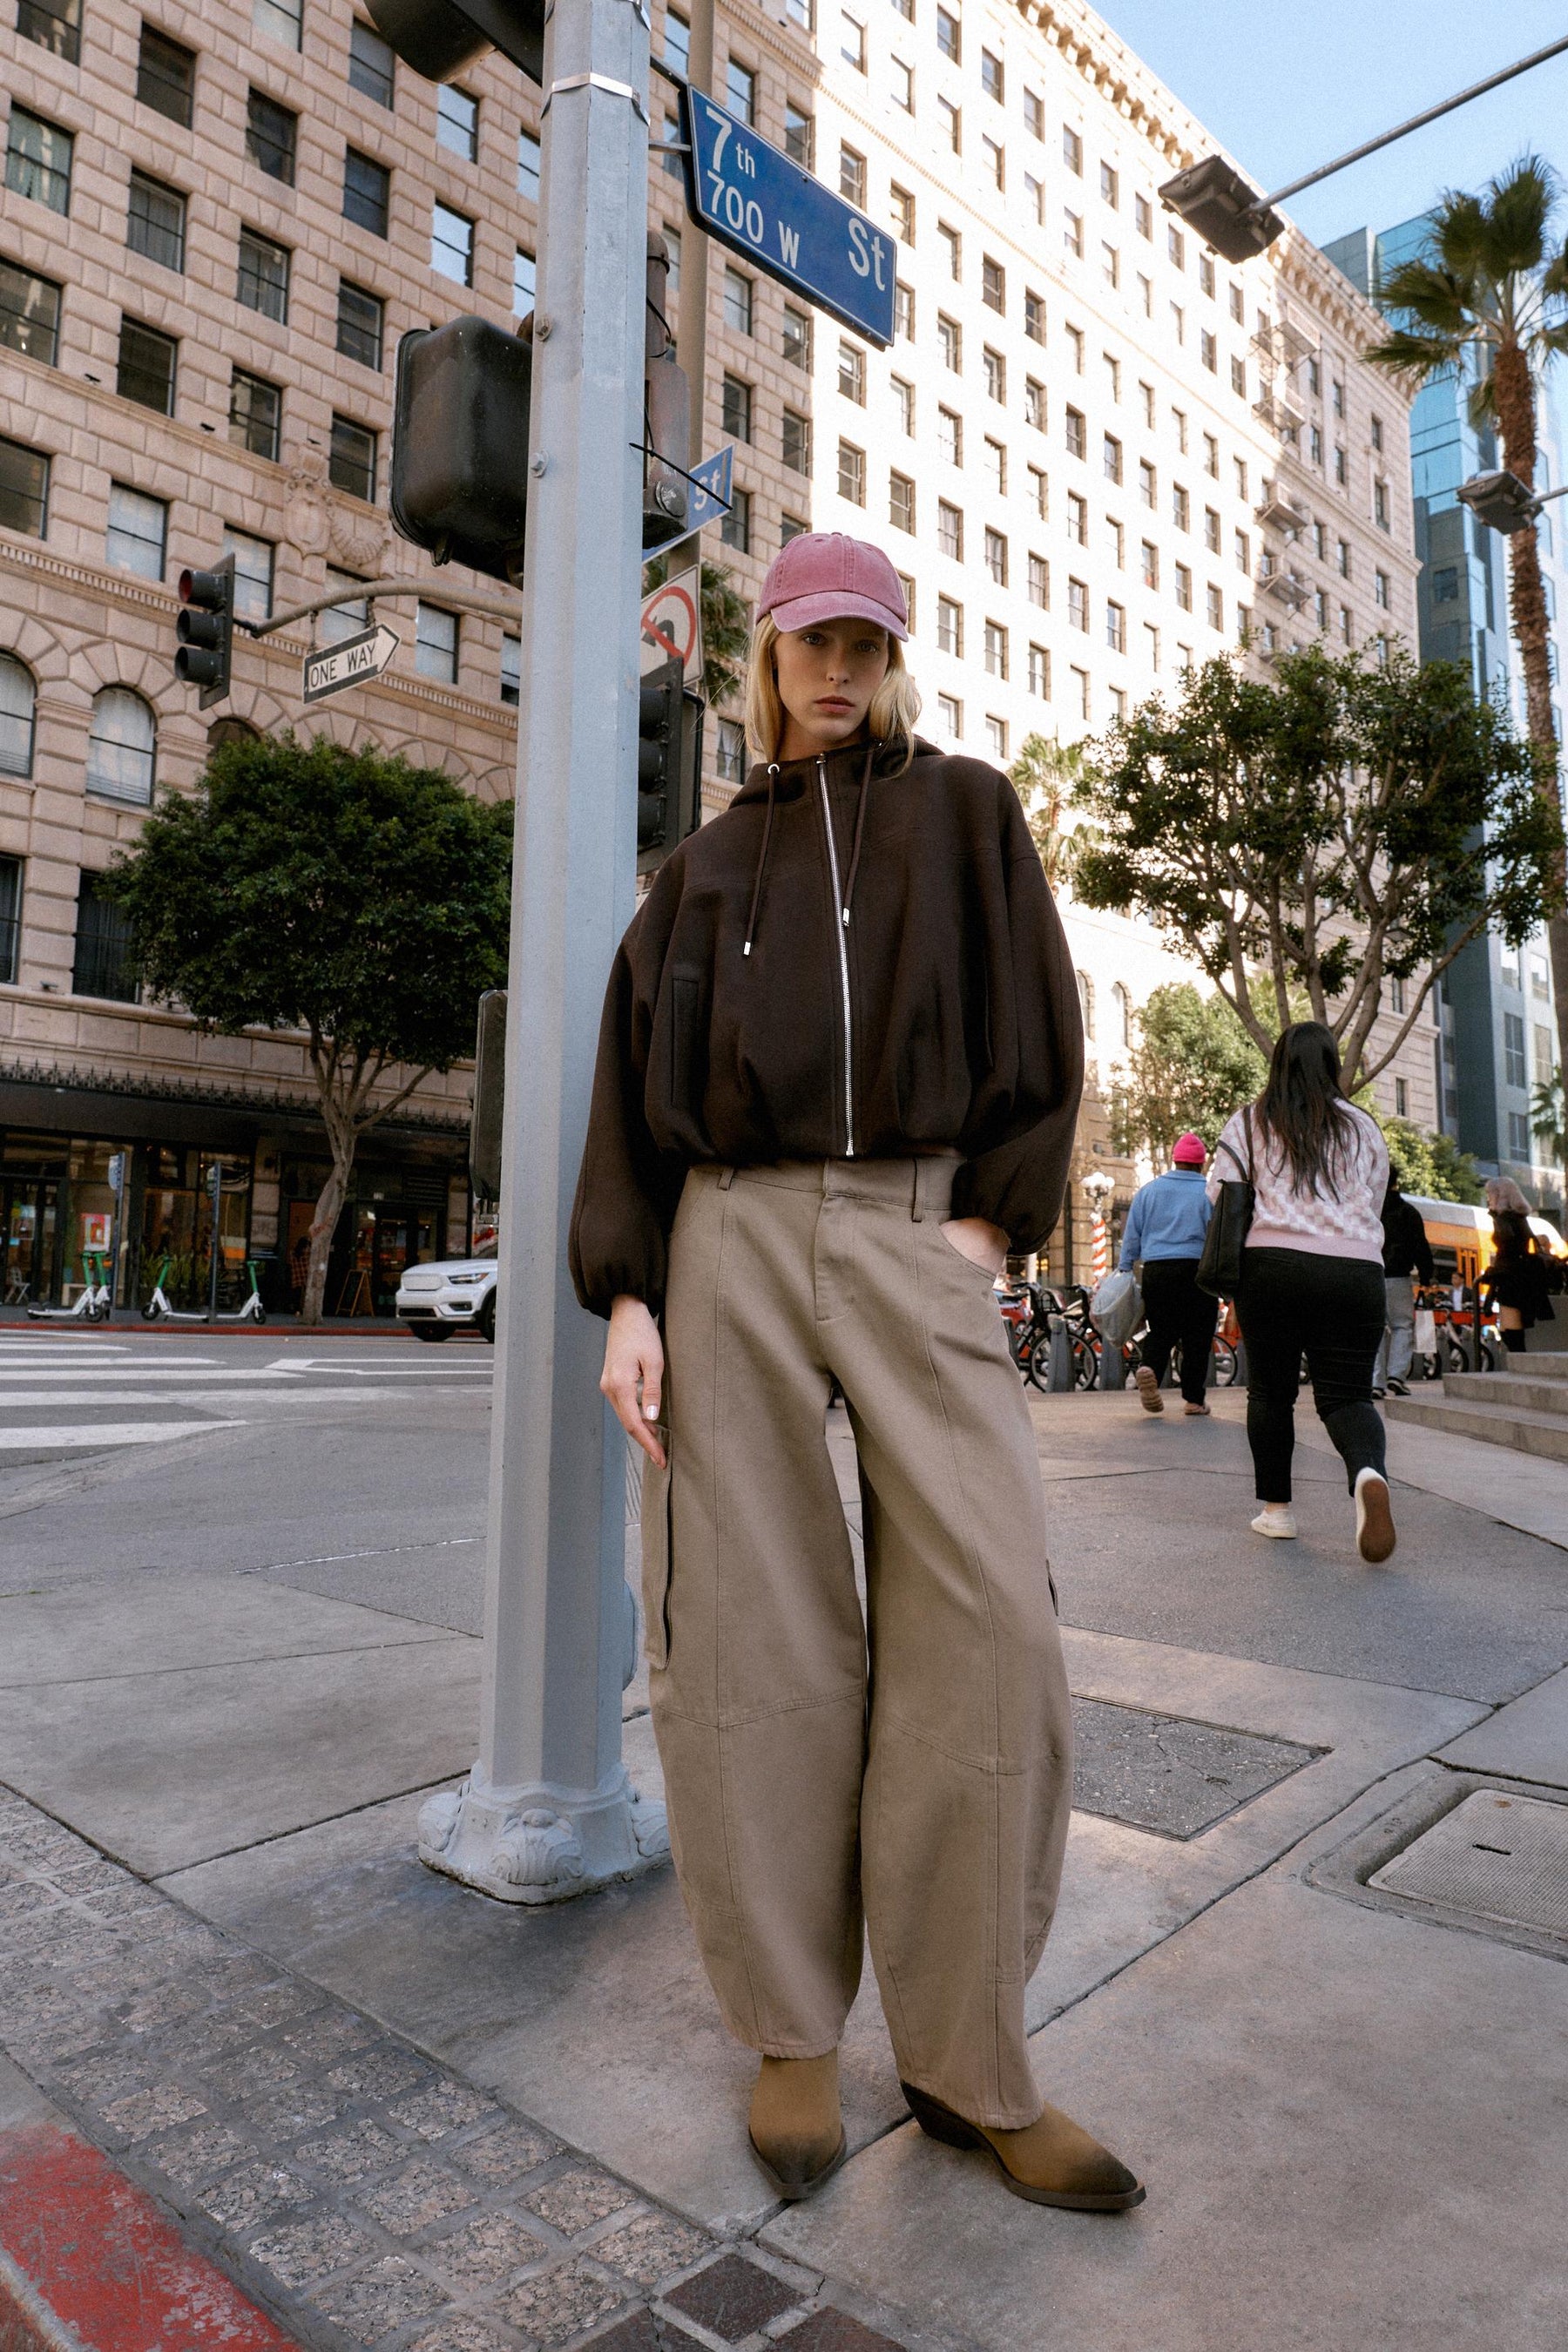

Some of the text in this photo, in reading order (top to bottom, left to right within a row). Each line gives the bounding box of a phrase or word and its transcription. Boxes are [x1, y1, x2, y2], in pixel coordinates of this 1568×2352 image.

[706, 170, 800, 269] 700 W
[848, 217, 885, 291] St
[694, 469, 720, 510] St
[310, 641, 376, 687] ONE WAY
